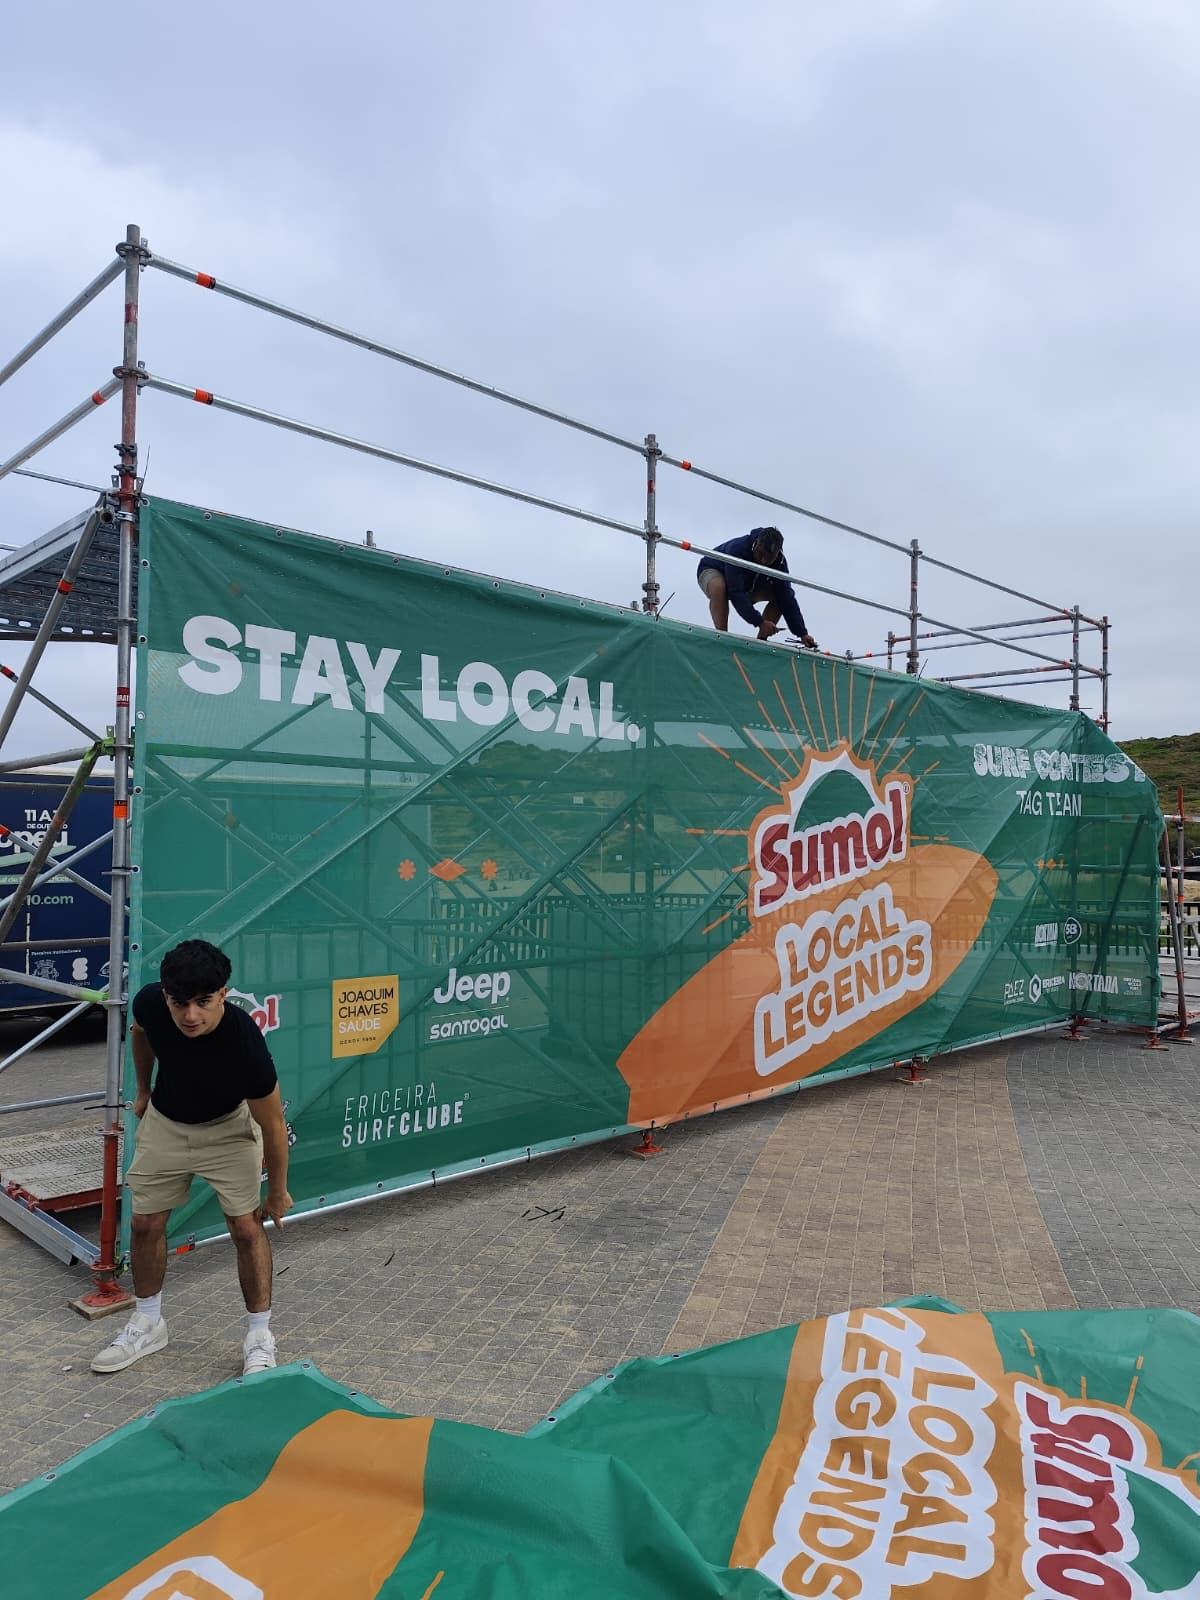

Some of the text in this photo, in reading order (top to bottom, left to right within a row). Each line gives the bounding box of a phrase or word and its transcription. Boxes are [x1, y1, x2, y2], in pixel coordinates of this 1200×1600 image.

[178, 615, 640, 742] STAY LOCAL.
[974, 743, 1032, 779] SURF
[1016, 791, 1042, 815] TAG
[759, 789, 904, 906] Sumol
[787, 896, 900, 987] LOCAL
[339, 987, 394, 1003] JOAQUIM
[434, 968, 511, 1004] Jeep
[764, 934, 925, 1060] LEGENDS
[339, 1002, 389, 1018] CHAVES
[339, 1017, 382, 1033] SAÚDE
[345, 1082, 436, 1121] ERICEIRA
[342, 1100, 464, 1147] SURFCLUBE
[781, 1307, 906, 1600] LEGENDS
[885, 1366, 976, 1567] LOCAL
